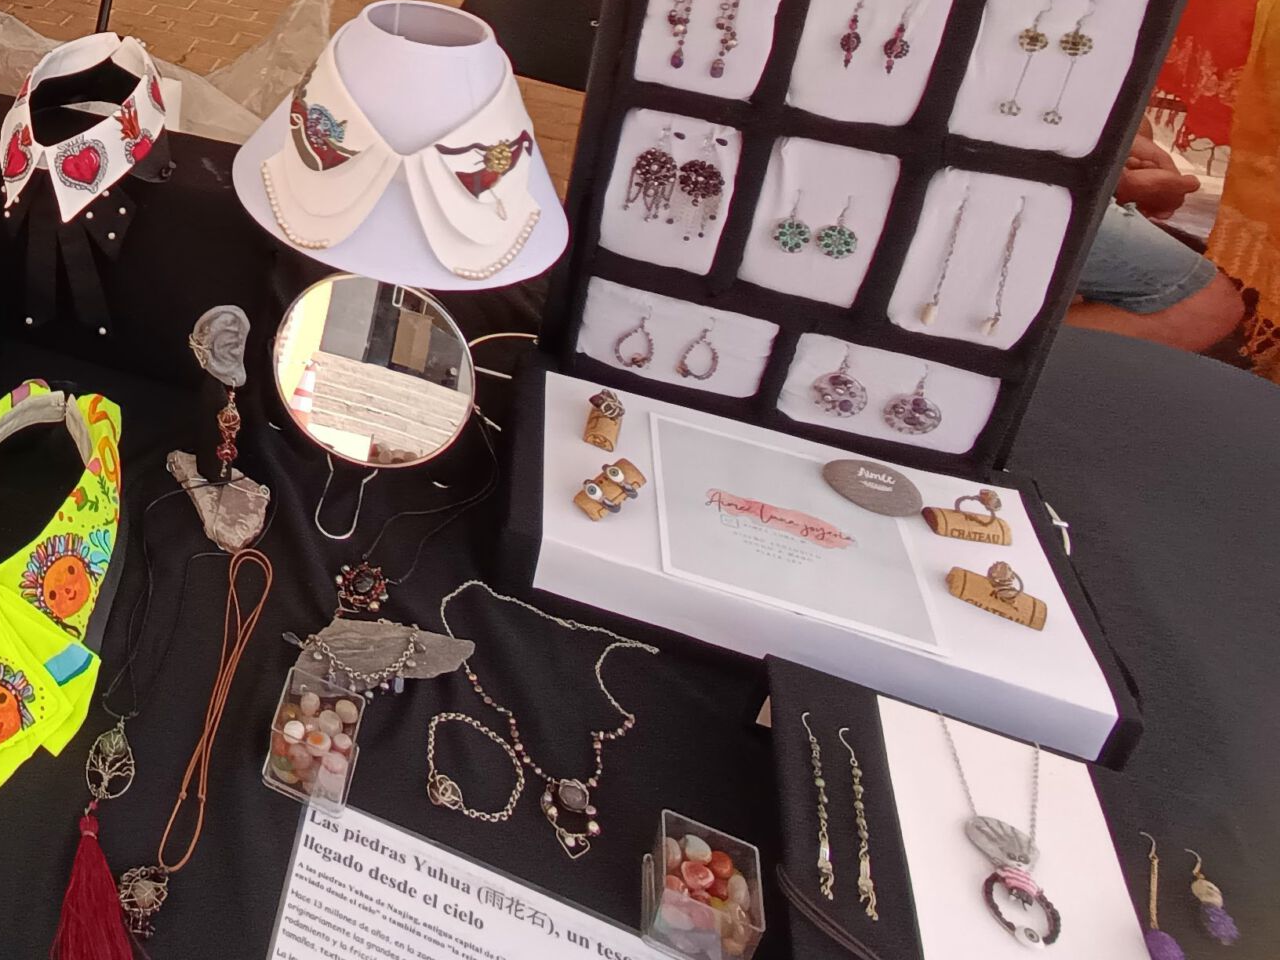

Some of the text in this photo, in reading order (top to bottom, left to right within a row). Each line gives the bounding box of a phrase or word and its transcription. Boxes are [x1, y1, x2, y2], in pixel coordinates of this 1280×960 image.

[294, 872, 324, 890] enviado
[326, 886, 348, 901] desde
[423, 934, 445, 948] como
[303, 834, 484, 930] llegado desde el cielo
[309, 809, 339, 833] Las
[343, 828, 407, 865] piedras
[413, 855, 471, 895] Yuhua
[567, 929, 590, 949] un
[318, 871, 346, 889] piedras
[348, 884, 374, 902] Yuhua
[375, 898, 385, 907] de
[422, 921, 453, 940] antigua
[454, 937, 483, 954] capital
[284, 915, 331, 942] rodamiento
[287, 902, 400, 960] originariamente las grandes
[290, 888, 312, 904] Hace
[324, 905, 357, 926] millones
[394, 940, 405, 950] en
